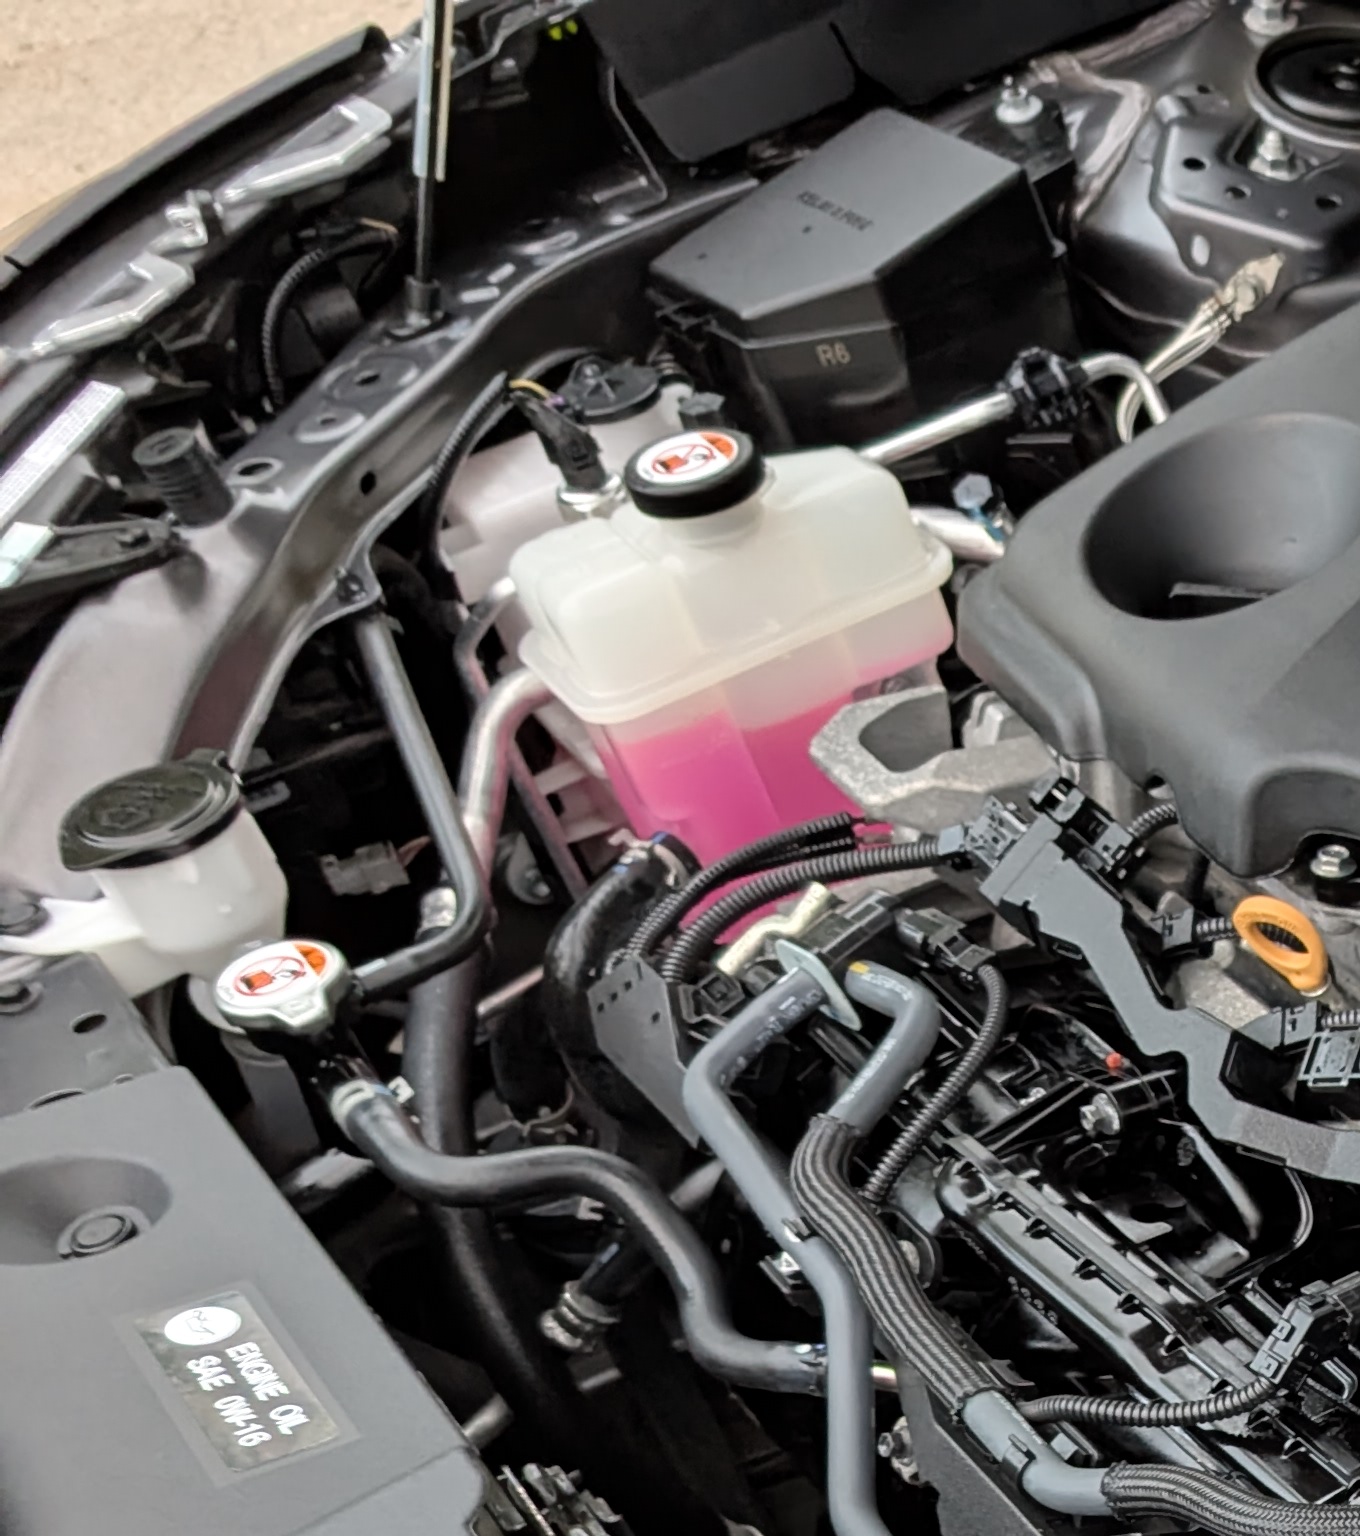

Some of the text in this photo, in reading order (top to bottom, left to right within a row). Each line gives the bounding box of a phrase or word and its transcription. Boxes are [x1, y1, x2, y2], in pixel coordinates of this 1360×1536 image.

[815, 342, 851, 367] R6
[187, 1355, 272, 1447] SAE 0W-16
[225, 1342, 310, 1435] ENGINE OIL
